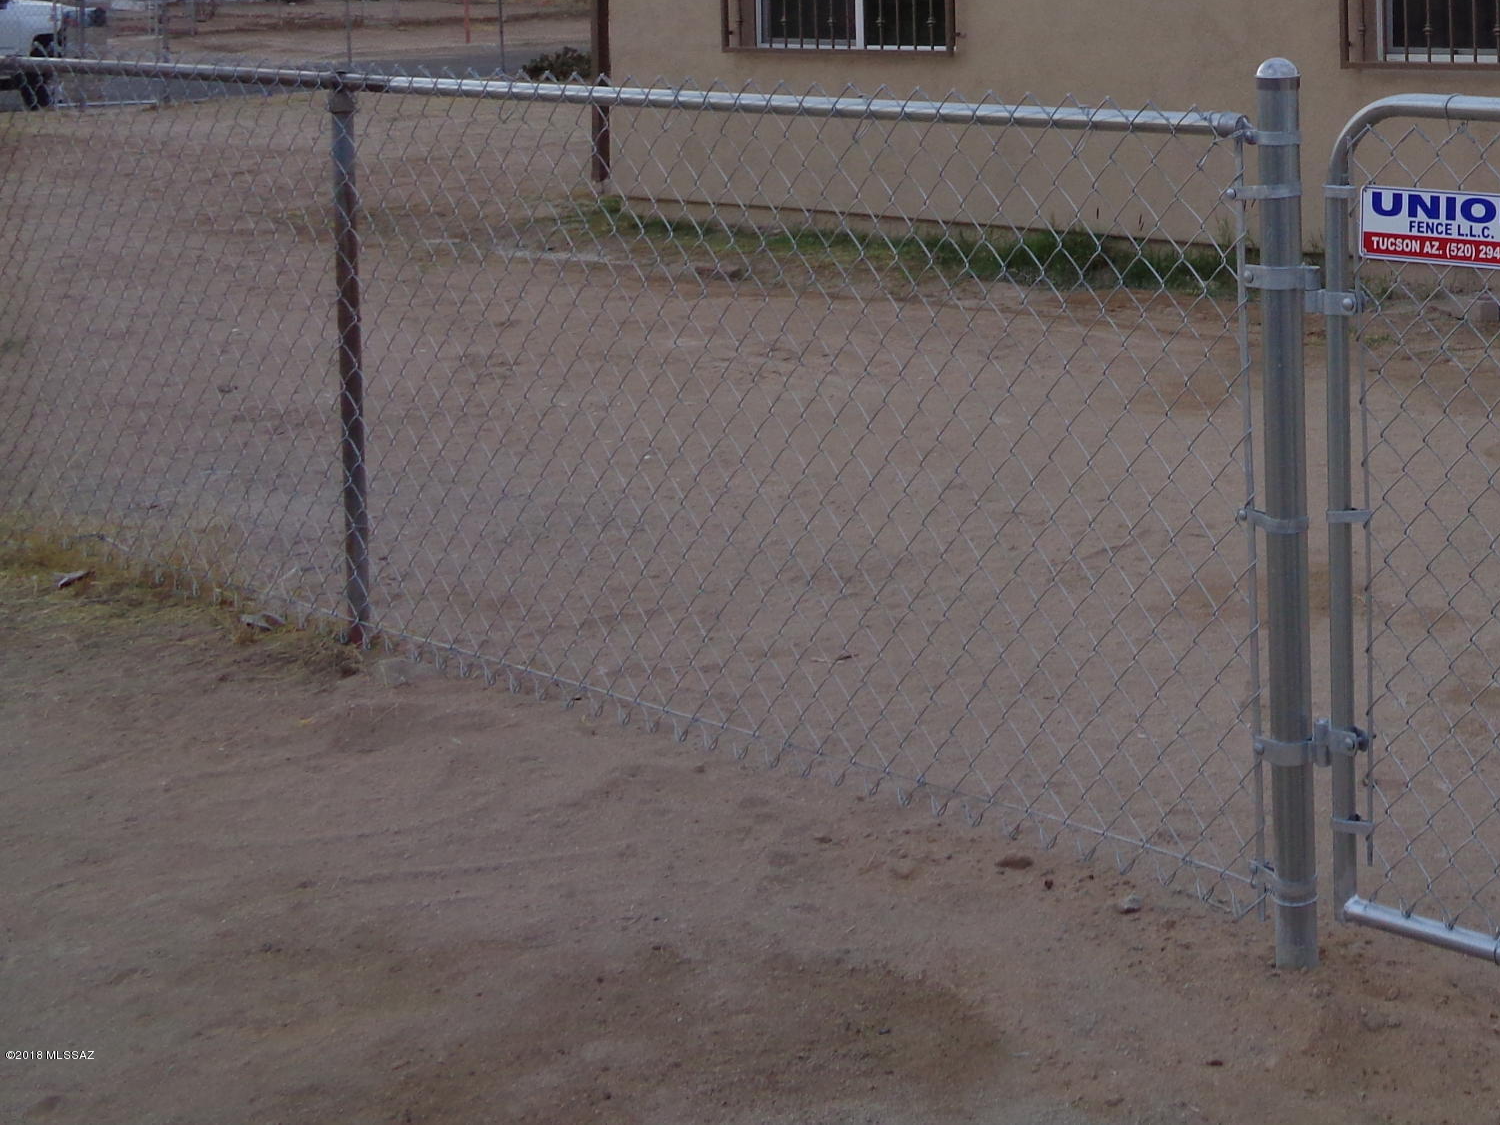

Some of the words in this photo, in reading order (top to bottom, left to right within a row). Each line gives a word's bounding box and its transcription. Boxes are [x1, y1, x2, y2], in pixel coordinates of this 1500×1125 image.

[1409, 221, 1452, 236] FENCE
[1457, 225, 1494, 239] L.L.C.
[1372, 236, 1420, 252] TUCSON
[1423, 243, 1443, 255] AZ.
[1446, 243, 1476, 260] (520)
